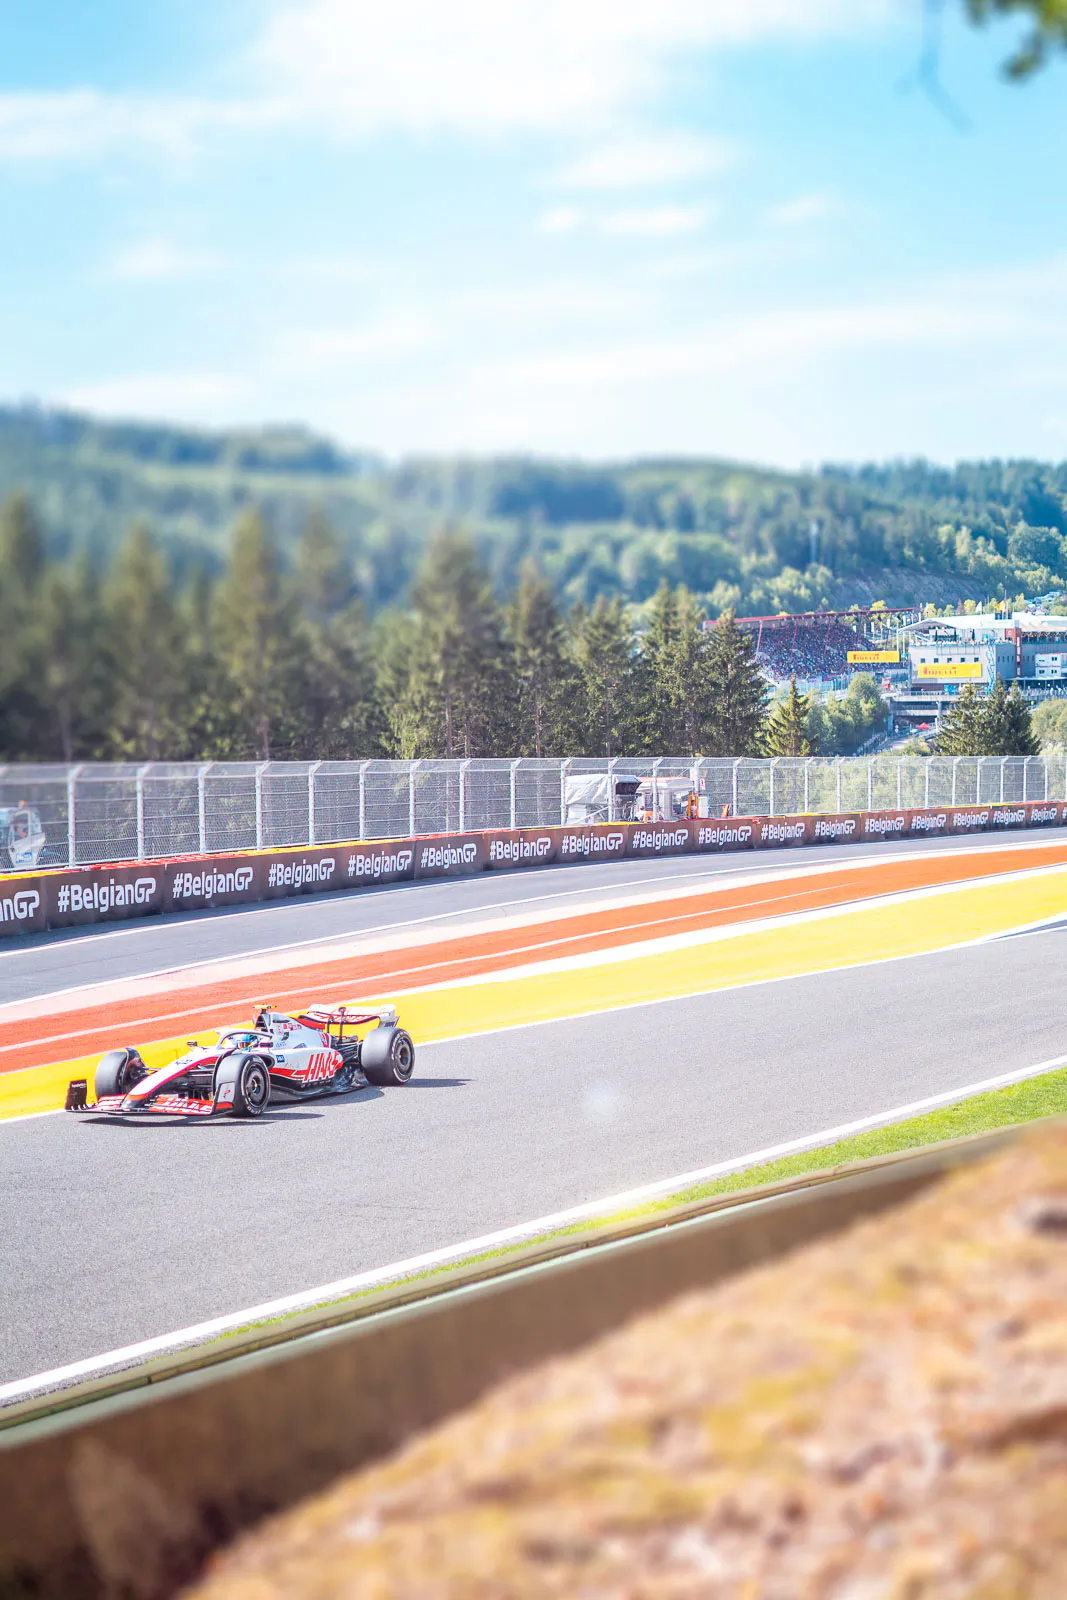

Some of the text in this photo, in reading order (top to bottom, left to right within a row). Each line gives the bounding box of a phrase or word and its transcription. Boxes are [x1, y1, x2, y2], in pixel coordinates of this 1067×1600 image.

[814, 820, 855, 837] #BelgianGP
[864, 817, 904, 833] #BelgianGP
[911, 814, 946, 830] #BelgianGP
[953, 812, 988, 827] #BelgianGP
[632, 829, 688, 849] #BelgianGP
[698, 826, 751, 845] #BelgianGP
[761, 823, 805, 841] #BelgianGP
[489, 837, 550, 861] #BelgianGP
[561, 832, 623, 855] #BelgianGP
[347, 849, 411, 877] #BelgianGP
[420, 843, 476, 868] #BelgianGP
[172, 866, 253, 898] #BelgianGP
[267, 857, 335, 888] #BelgianGP
[57, 877, 156, 912] #BelgianGP
